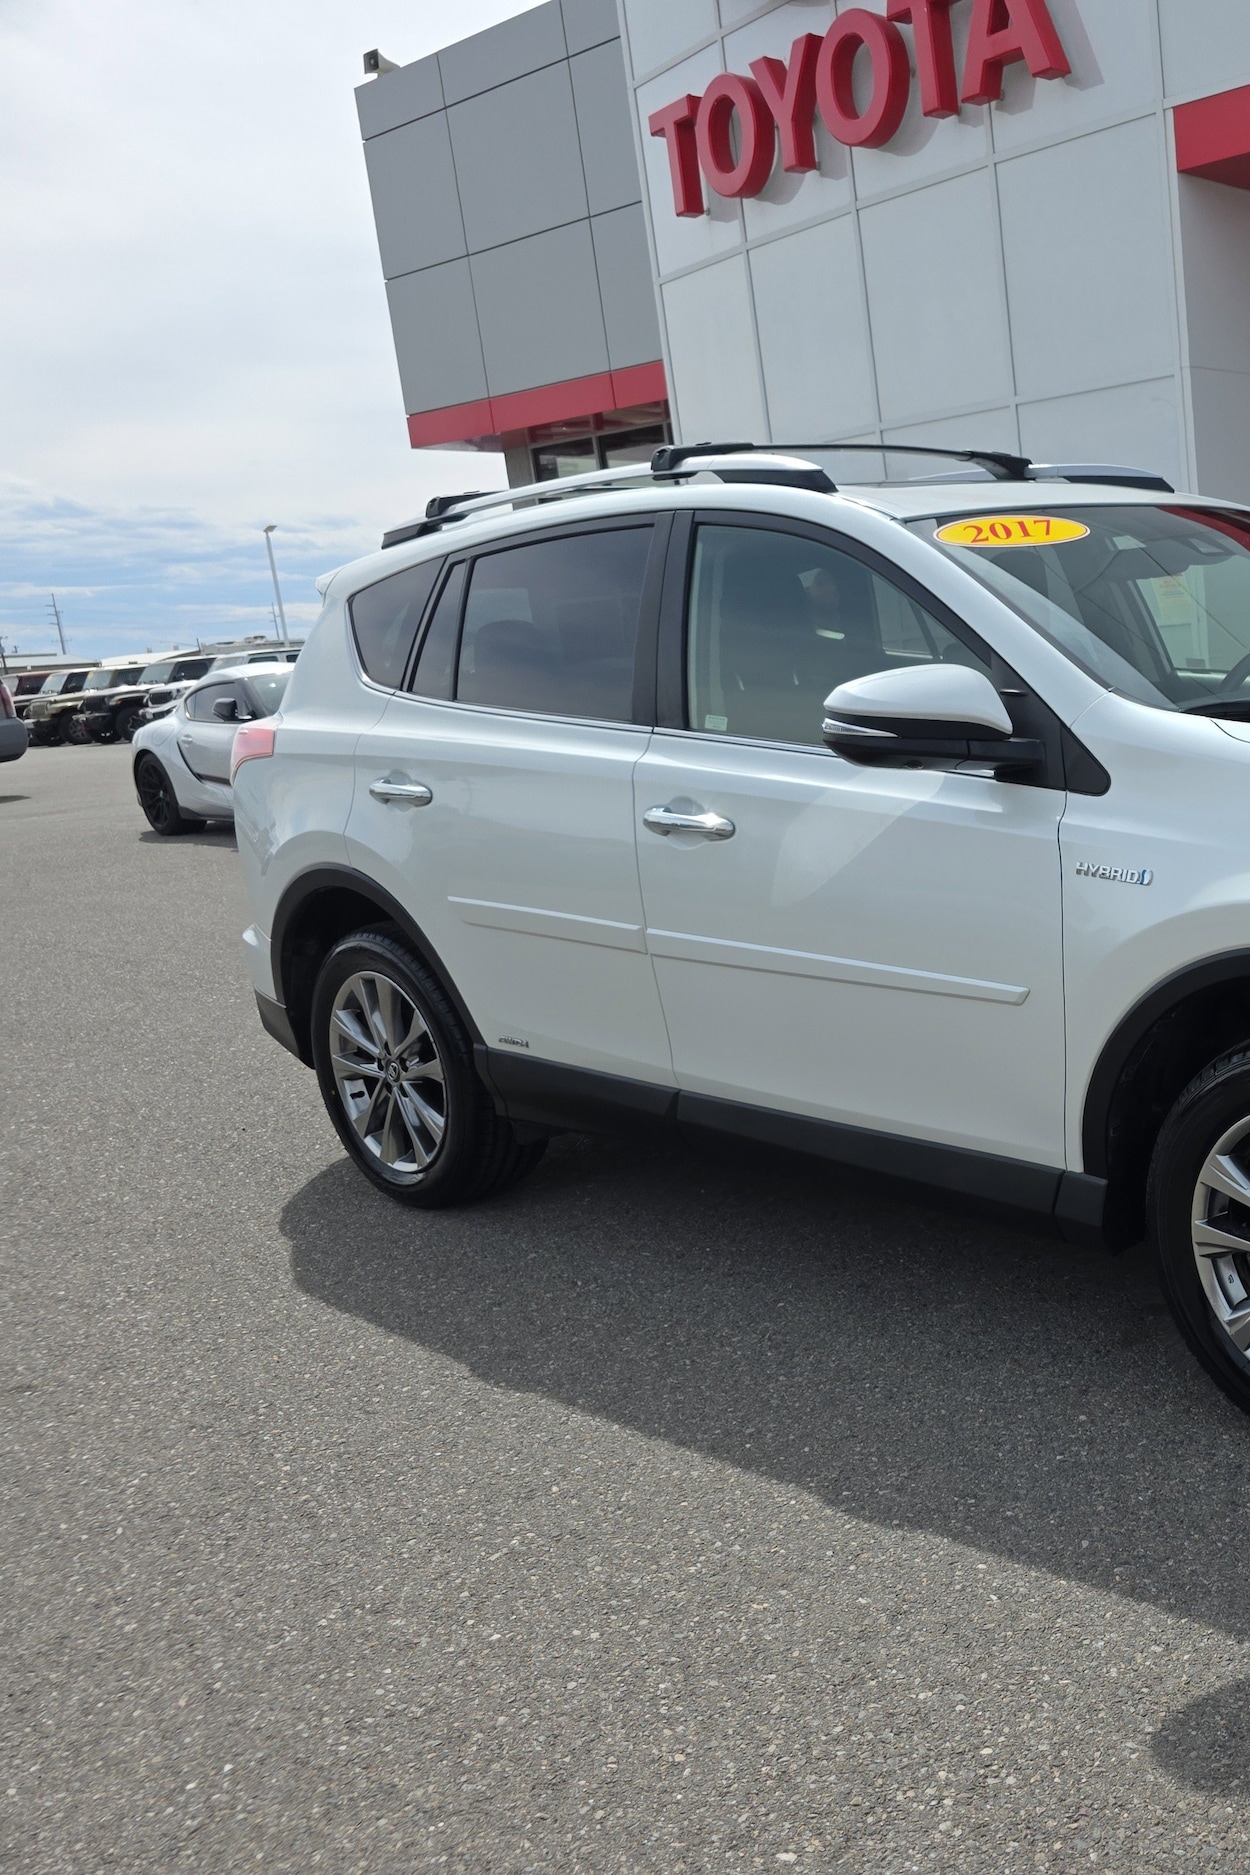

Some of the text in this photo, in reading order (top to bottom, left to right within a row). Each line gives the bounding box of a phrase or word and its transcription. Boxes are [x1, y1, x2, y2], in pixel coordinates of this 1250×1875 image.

[648, 0, 1071, 218] TOYOTA
[963, 519, 1051, 543] 2017
[1076, 861, 1139, 884] HYBRID
